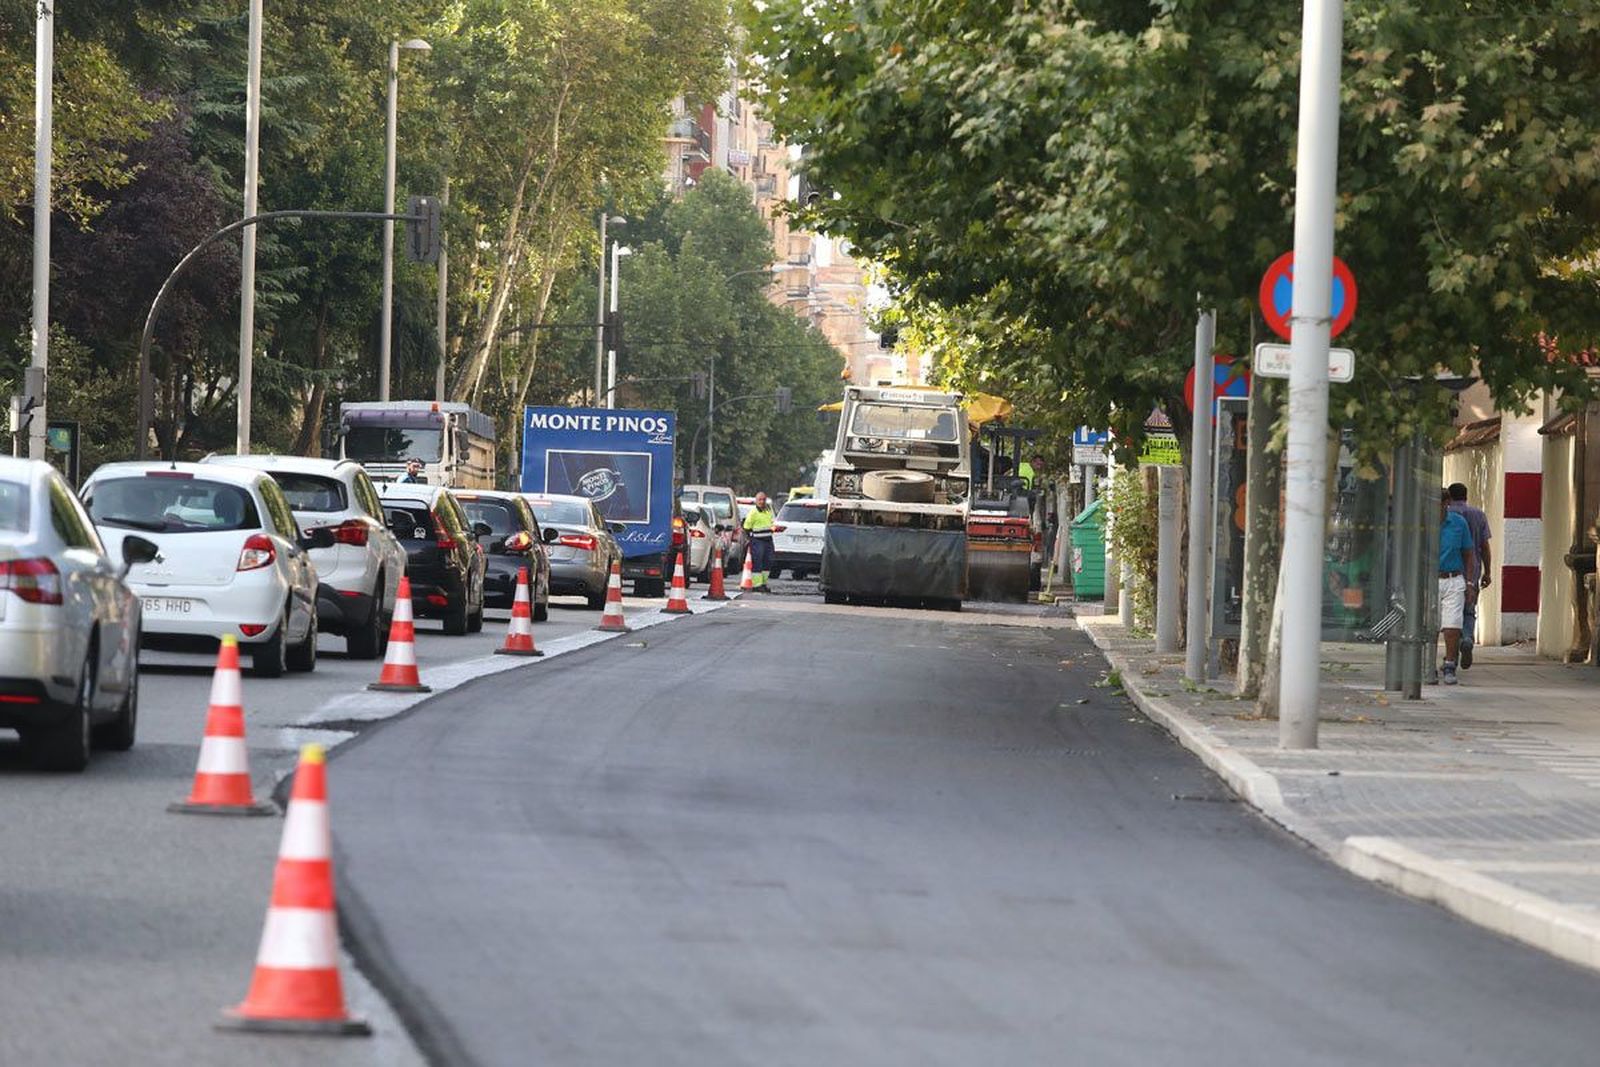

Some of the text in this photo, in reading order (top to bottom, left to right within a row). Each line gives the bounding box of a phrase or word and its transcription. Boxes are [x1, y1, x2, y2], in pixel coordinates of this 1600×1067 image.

[530, 413, 668, 434] MONTE PINOS
[165, 600, 192, 613] HHD
